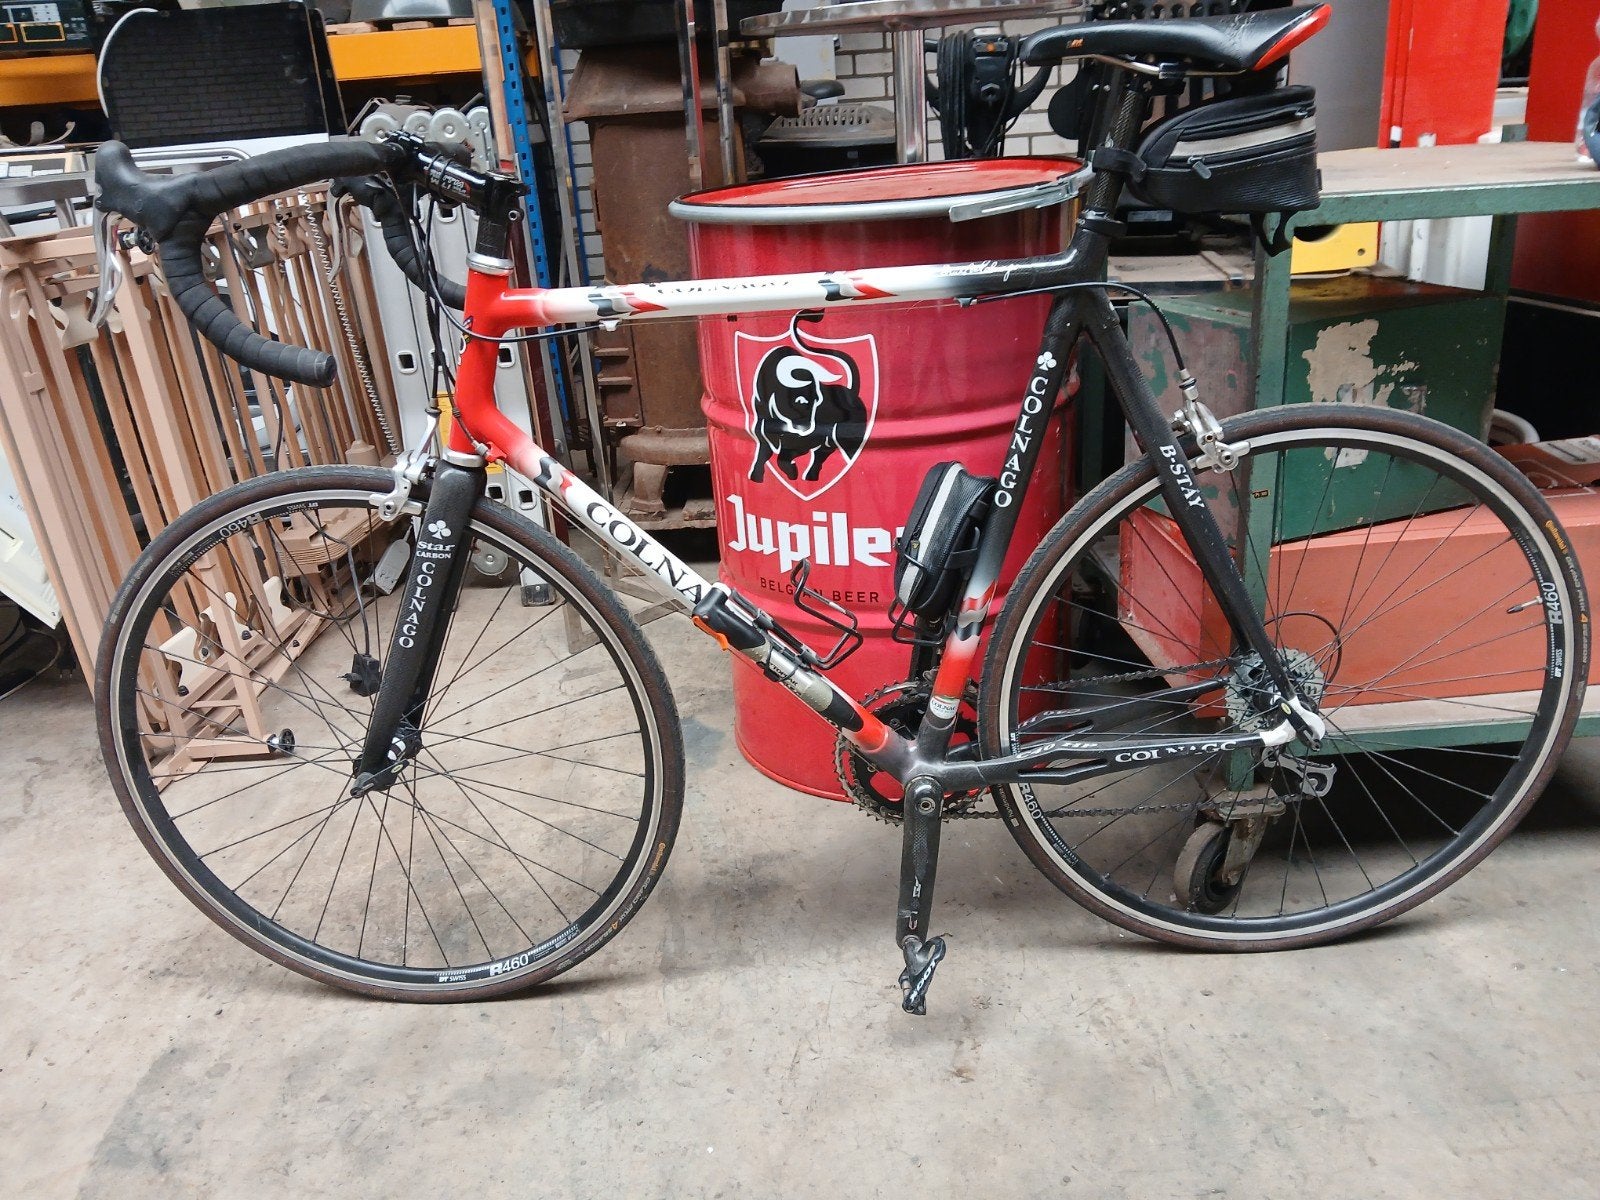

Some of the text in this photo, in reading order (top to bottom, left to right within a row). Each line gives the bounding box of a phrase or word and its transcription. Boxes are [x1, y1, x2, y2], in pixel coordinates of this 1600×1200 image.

[994, 376, 1048, 508] COLNAGO
[1159, 445, 1205, 508] B-STAY
[416, 541, 456, 552] Star
[416, 551, 452, 559] CARBON
[399, 561, 436, 649] COLNAGO
[760, 576, 879, 603] BELGAN BEER
[1541, 582, 1564, 625] R460
[1020, 782, 1042, 820] R460
[449, 974, 467, 982] SWISS
[489, 954, 529, 977] R460
